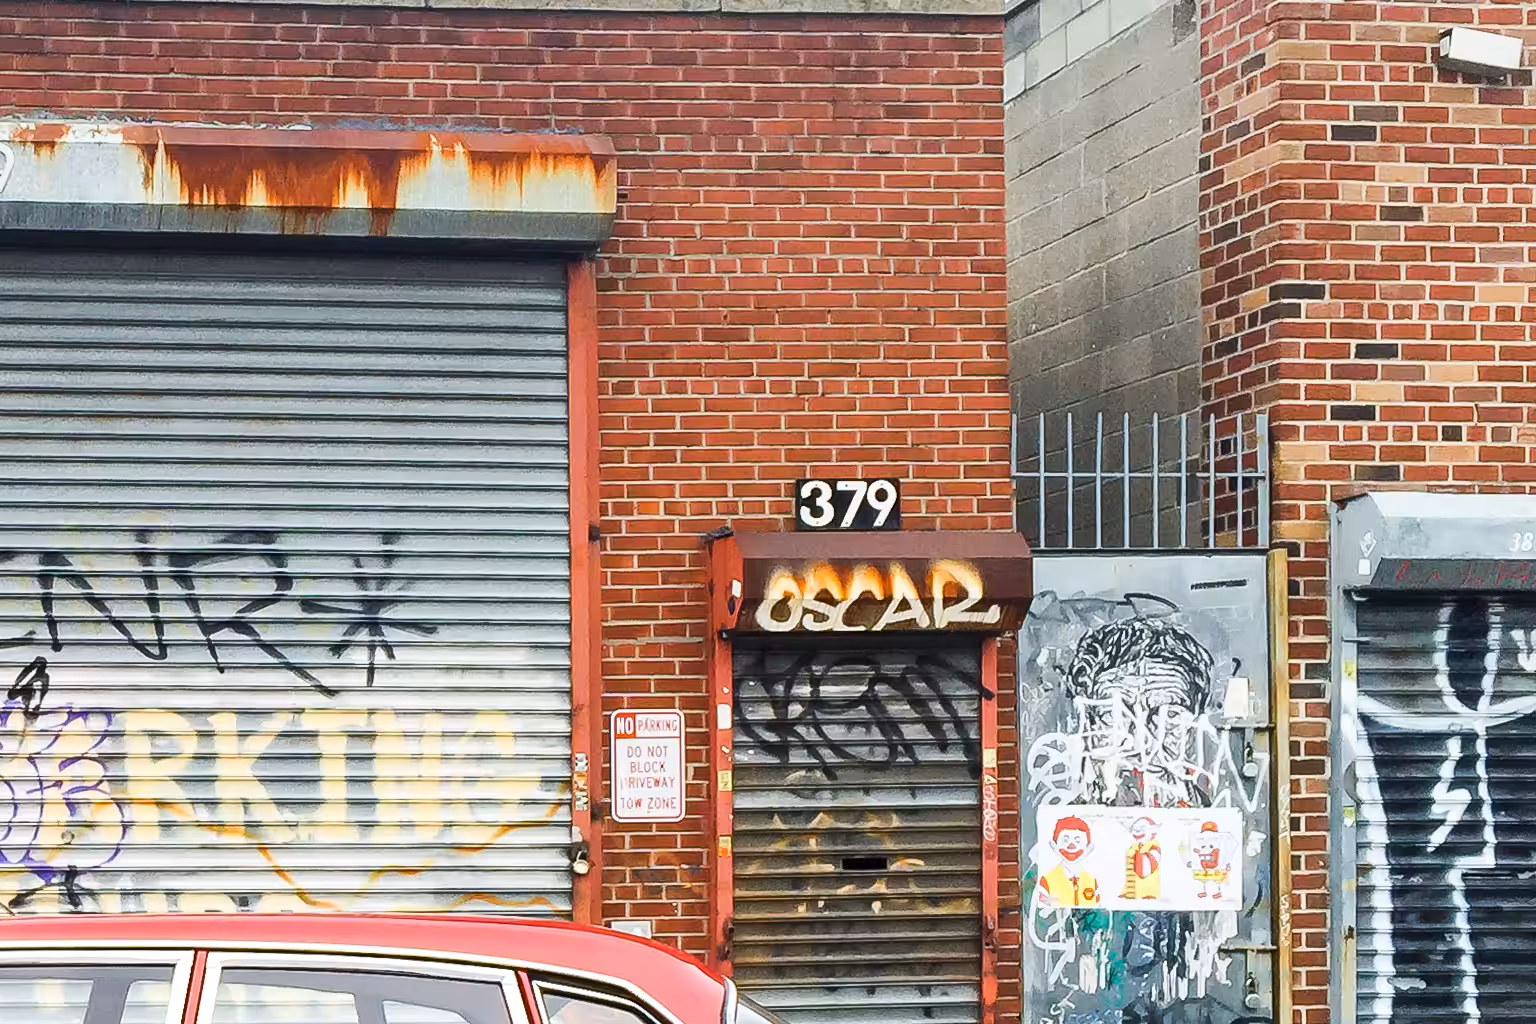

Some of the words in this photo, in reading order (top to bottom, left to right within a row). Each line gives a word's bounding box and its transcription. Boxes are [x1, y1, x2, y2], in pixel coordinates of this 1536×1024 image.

[799, 479, 898, 528] 379
[1509, 532, 1536, 552] 38
[755, 559, 1001, 632] OSCAR
[616, 717, 634, 735] NO
[638, 719, 678, 732] PARKING
[627, 746, 642, 758] DO
[648, 746, 668, 757] NOT
[630, 761, 666, 773] BLOCK
[621, 798, 642, 809] TOW
[648, 797, 677, 809] ZONE
